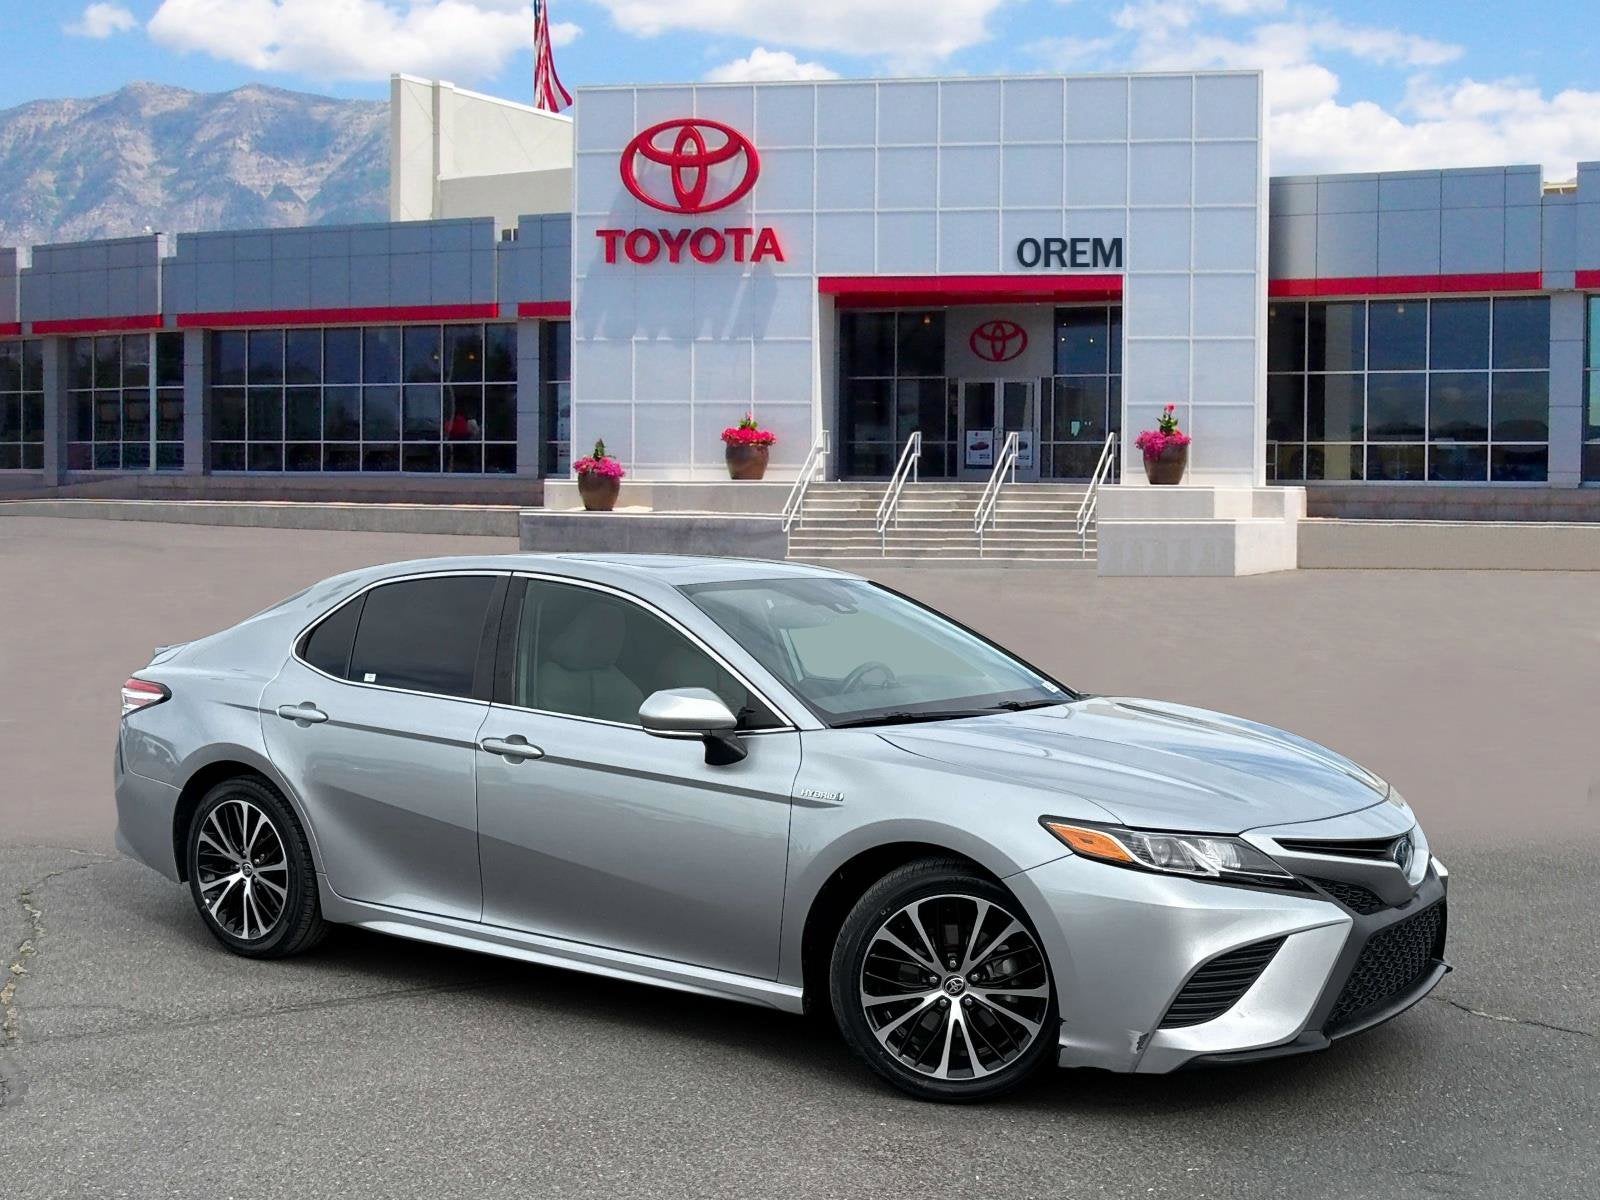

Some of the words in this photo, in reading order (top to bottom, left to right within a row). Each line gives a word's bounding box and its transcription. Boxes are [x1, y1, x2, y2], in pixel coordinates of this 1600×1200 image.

[596, 227, 785, 263] TOYOTA
[1016, 237, 1123, 268] OREM
[800, 788, 837, 801] HYBRID
